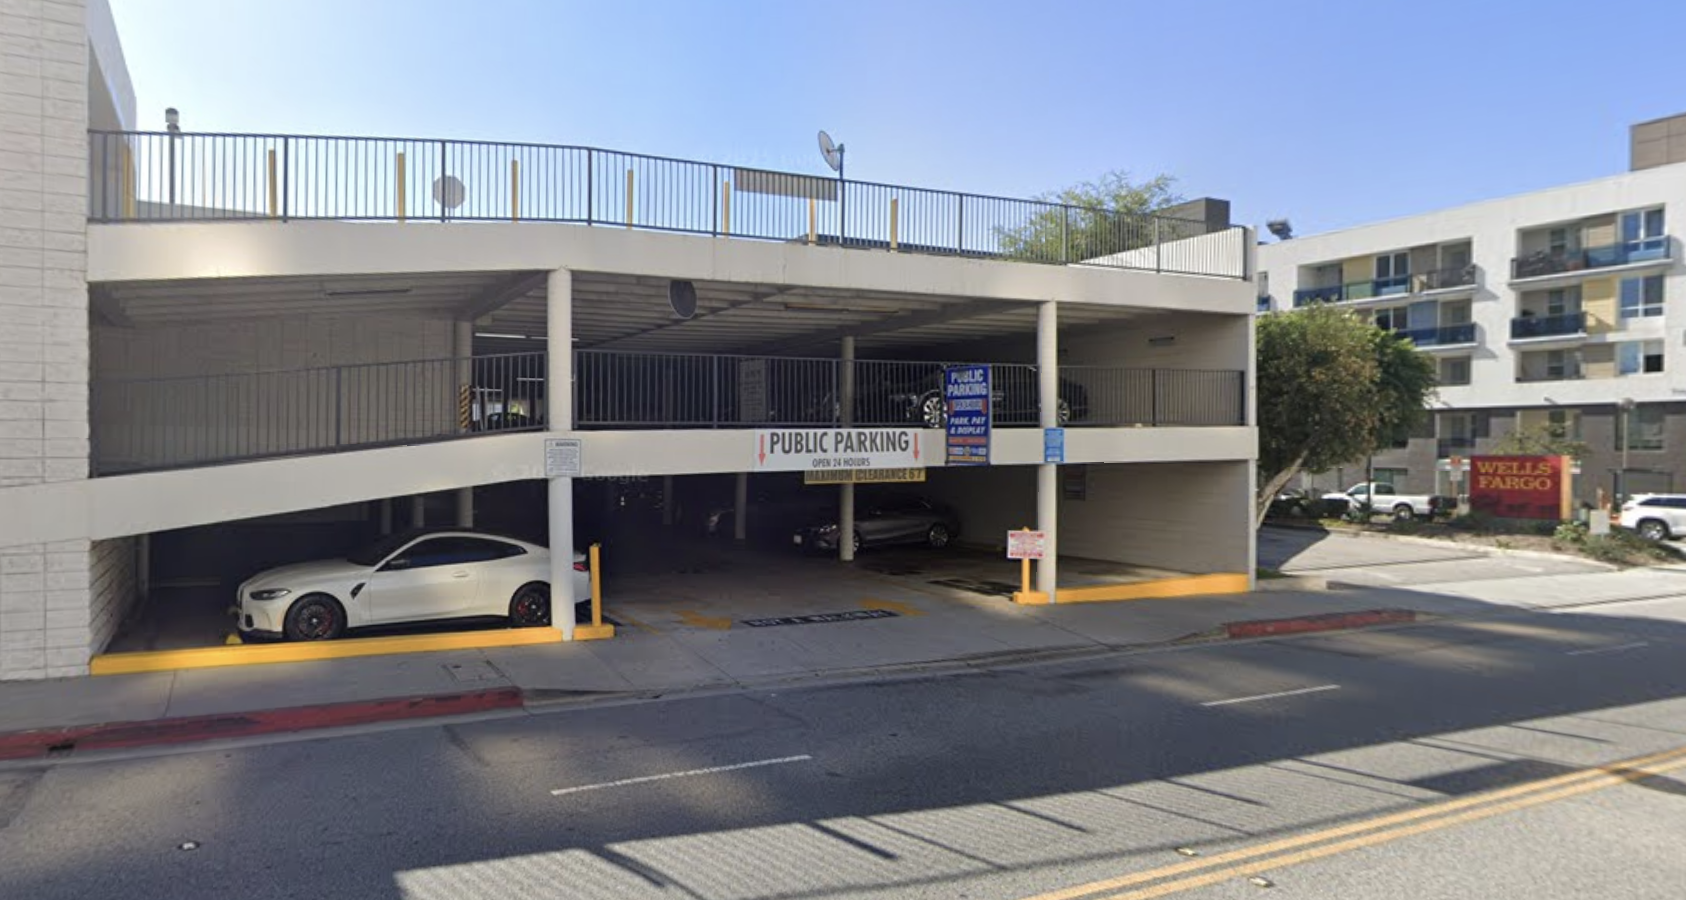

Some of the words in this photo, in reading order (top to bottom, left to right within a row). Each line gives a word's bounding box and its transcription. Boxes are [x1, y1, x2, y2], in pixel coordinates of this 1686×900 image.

[951, 369, 984, 383] PUBLIC
[947, 382, 988, 396] PARKING
[971, 416, 986, 425] PAY
[957, 426, 986, 434] DISPLAY
[770, 431, 828, 454] PUBLIC
[834, 430, 910, 453] PARKING
[812, 459, 831, 468] OPEN
[833, 458, 842, 467] 24
[1477, 461, 1551, 475] WELLS
[806, 469, 853, 482] MAXIMUM
[855, 468, 907, 480] CLEARANCE
[1479, 475, 1552, 490] FARGO
